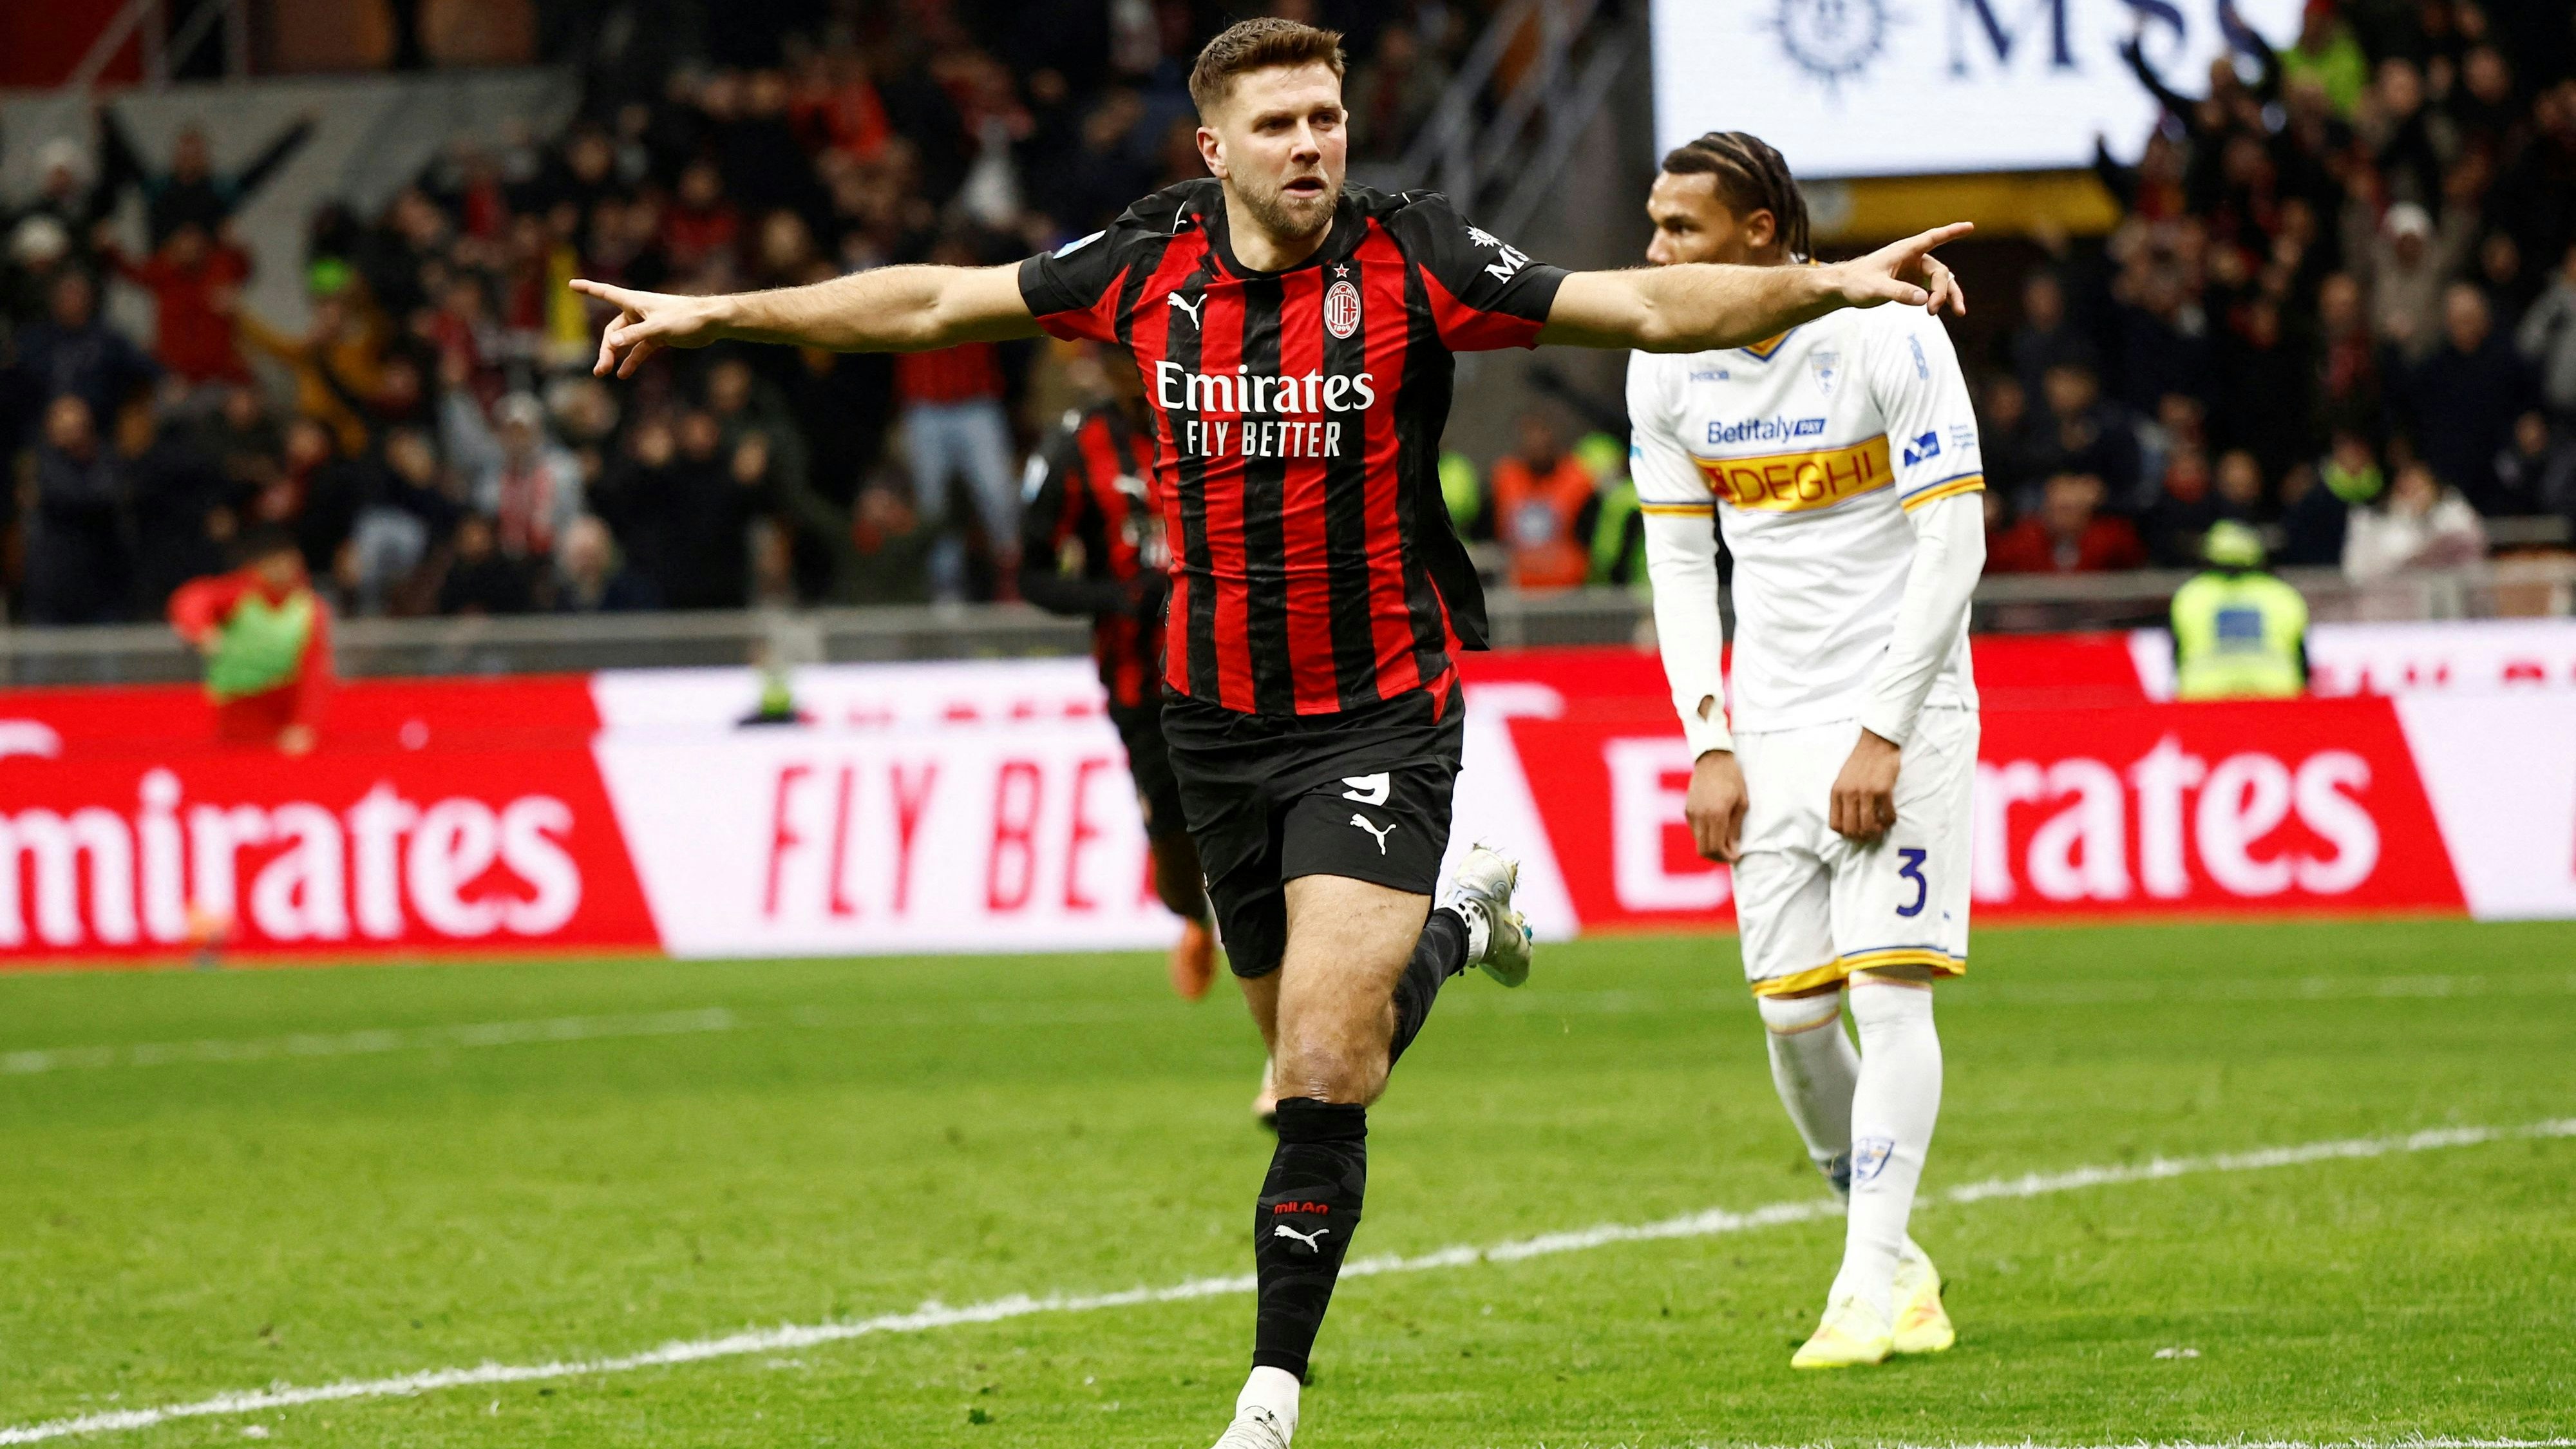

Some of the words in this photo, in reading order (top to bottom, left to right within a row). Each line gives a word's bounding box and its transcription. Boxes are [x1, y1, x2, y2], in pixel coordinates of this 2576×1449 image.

[1332, 285, 1354, 298] ACM
[1332, 324, 1352, 332] 1899
[1155, 360, 1376, 413] Emirates
[1187, 420, 1229, 457] FLY
[1241, 421, 1341, 457] BETTER
[1708, 415, 1794, 444] Betitaly
[1730, 451, 1873, 504] DEGHI
[760, 760, 939, 921] FLY
[980, 755, 1160, 918] BE
[1602, 737, 2381, 911] Erates
[1895, 847, 1927, 918] 3
